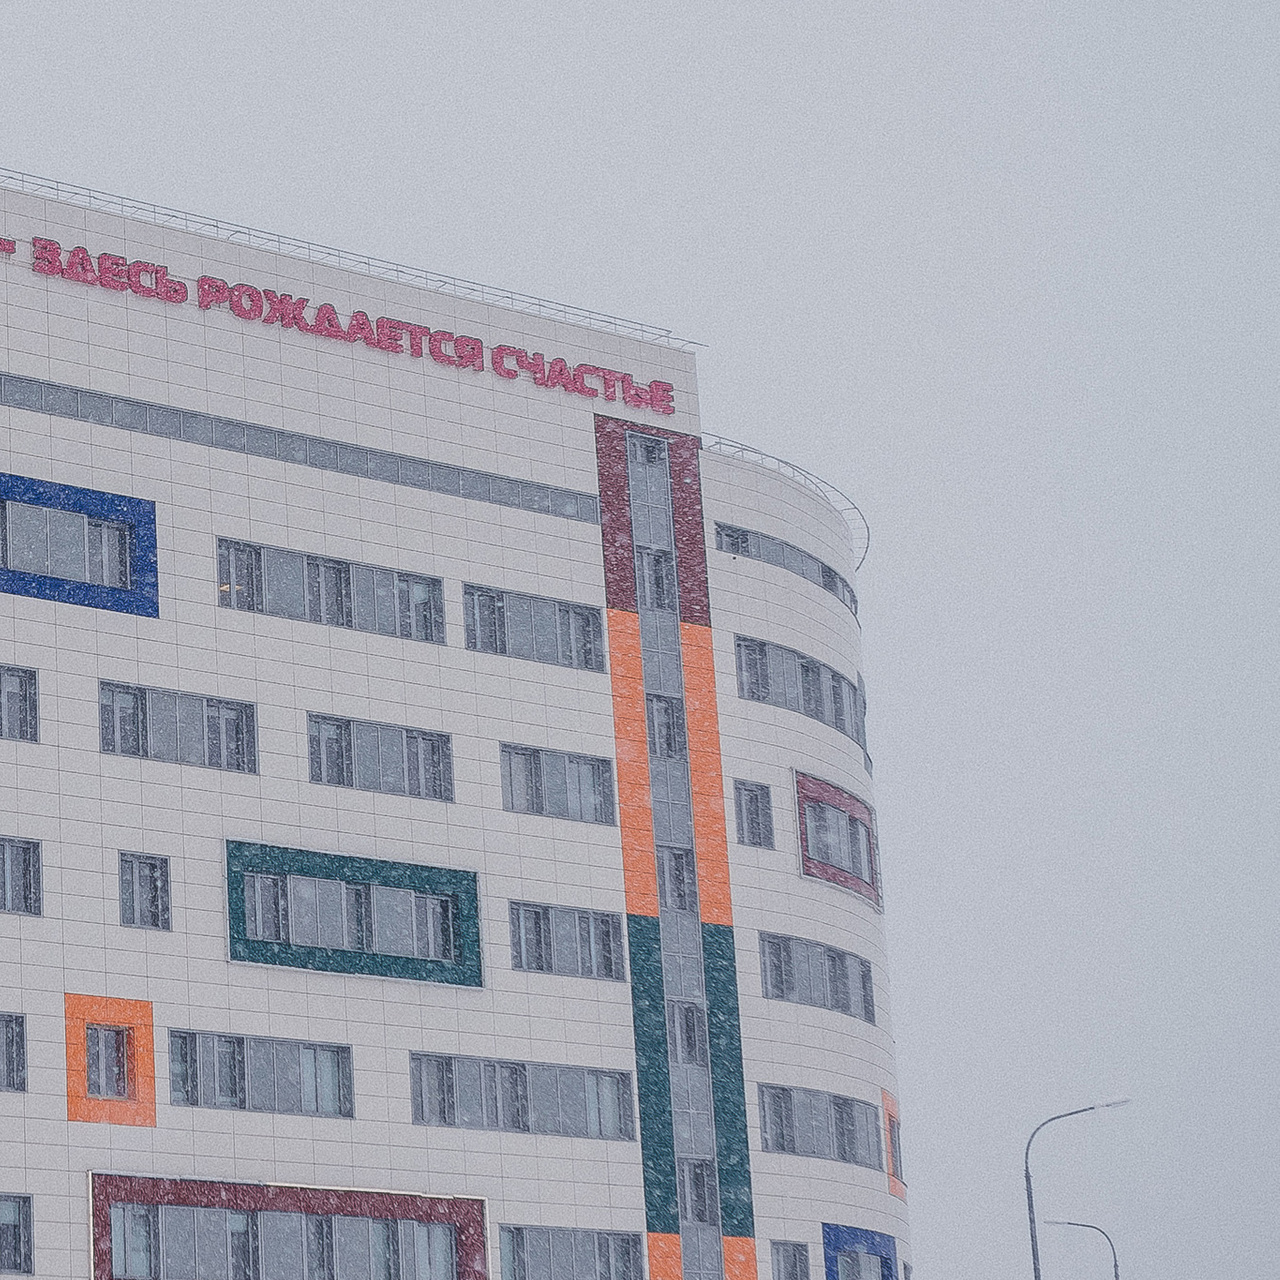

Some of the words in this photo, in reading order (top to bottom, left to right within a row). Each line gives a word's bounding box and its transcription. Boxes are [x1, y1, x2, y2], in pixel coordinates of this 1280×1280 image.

[32, 236, 189, 305] ЗДЕСЬ
[197, 275, 485, 372] РОЖДАЕТСЯ
[491, 344, 675, 416] СЧАСТЬЕ
